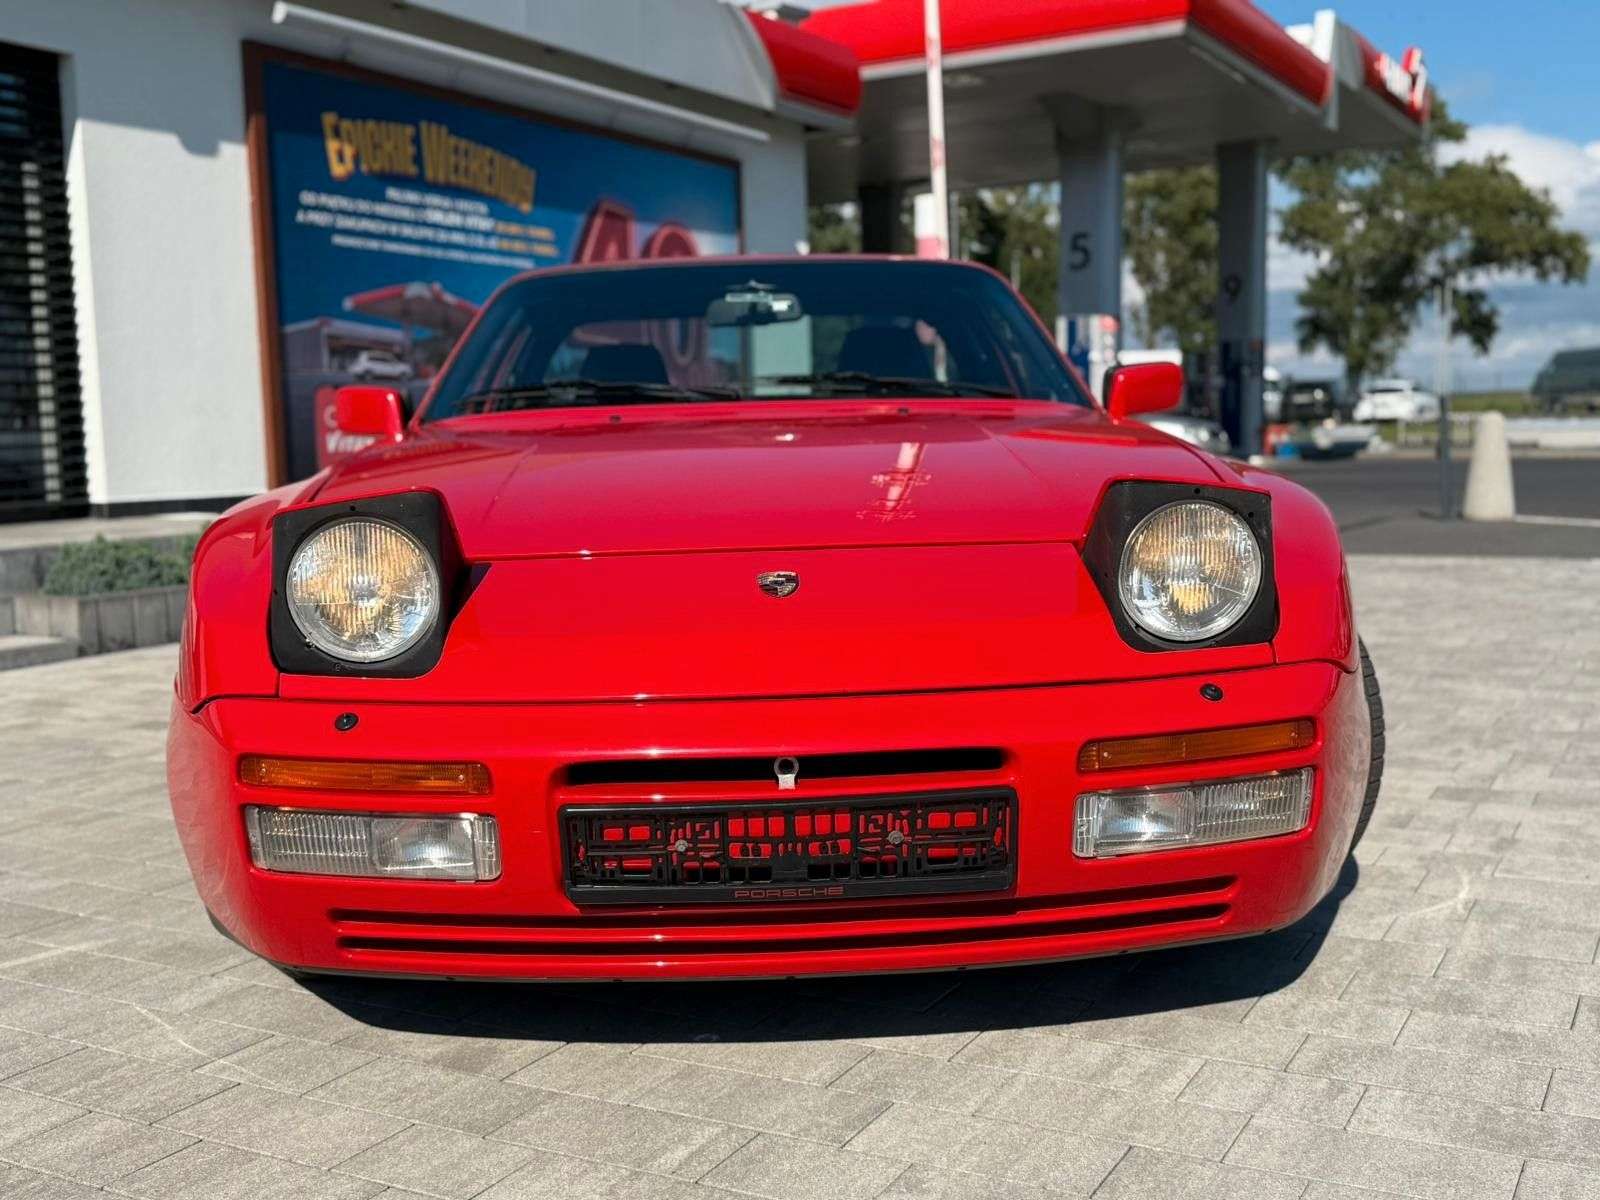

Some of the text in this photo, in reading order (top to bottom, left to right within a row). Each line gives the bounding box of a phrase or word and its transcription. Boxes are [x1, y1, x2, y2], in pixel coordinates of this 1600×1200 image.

[1069, 231, 1091, 271] 5
[1224, 274, 1242, 303] 9
[734, 886, 845, 899] PORSCHE
